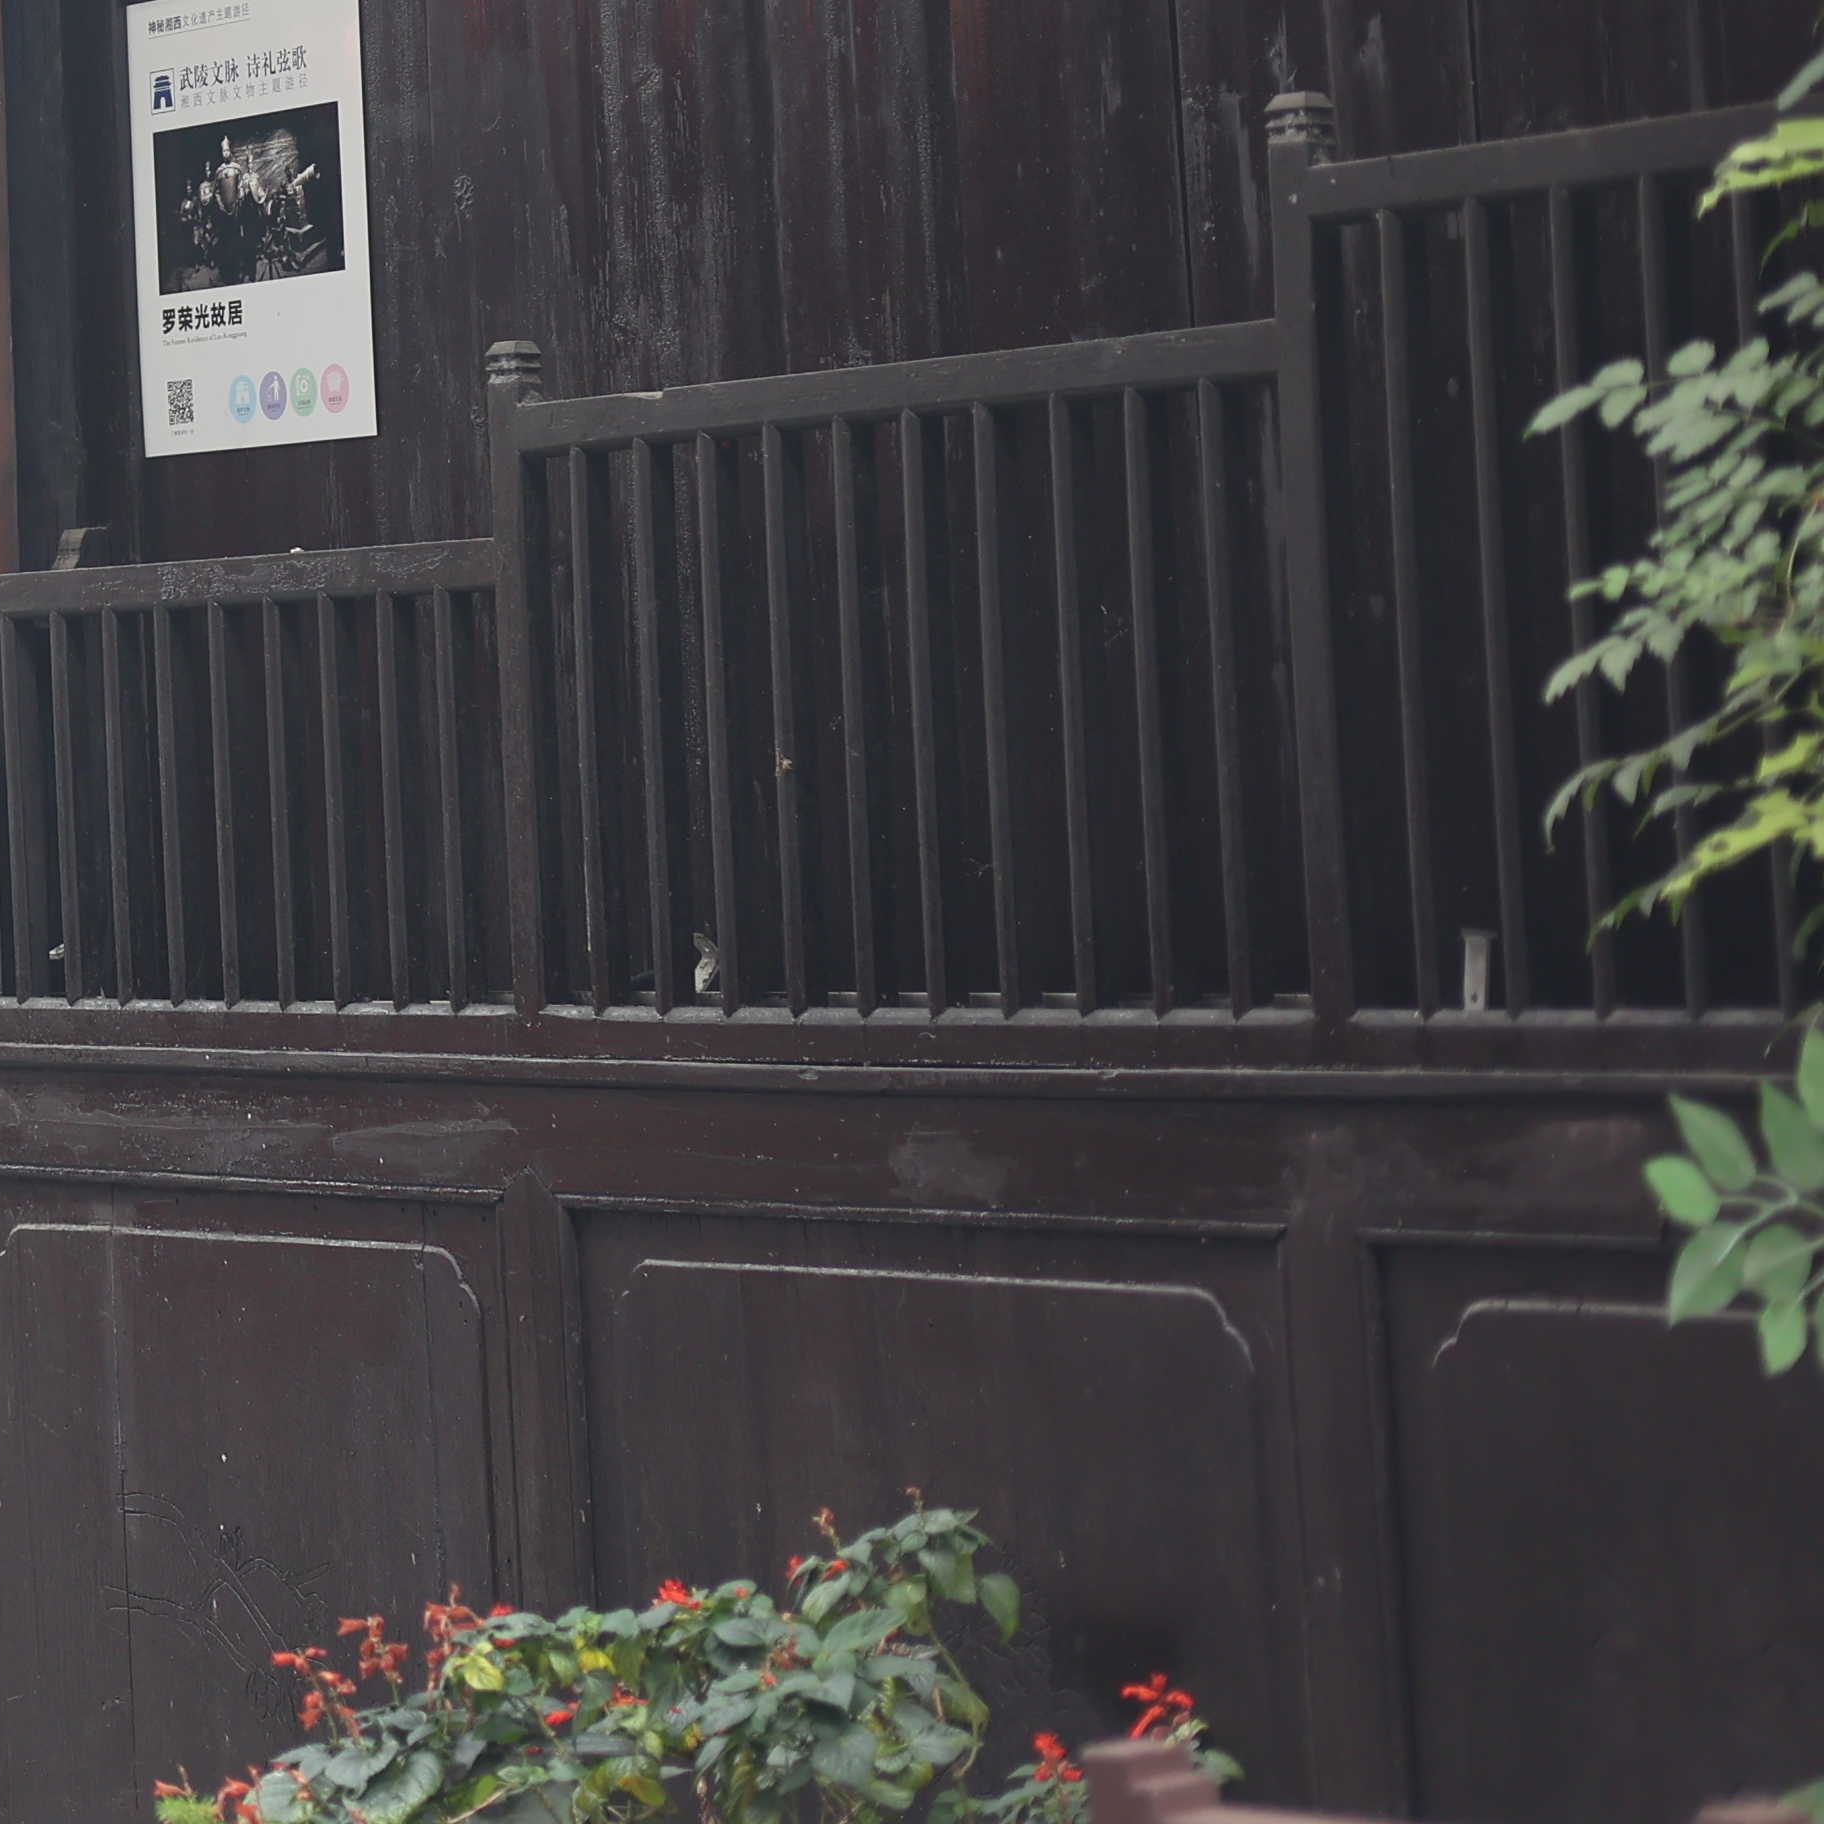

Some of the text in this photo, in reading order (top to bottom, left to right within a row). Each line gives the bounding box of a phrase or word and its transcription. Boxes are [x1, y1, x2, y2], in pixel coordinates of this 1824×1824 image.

[180, 45, 307, 91] 武陵文脉 诗礼弦歌
[162, 299, 243, 335] 罗荣光故居
